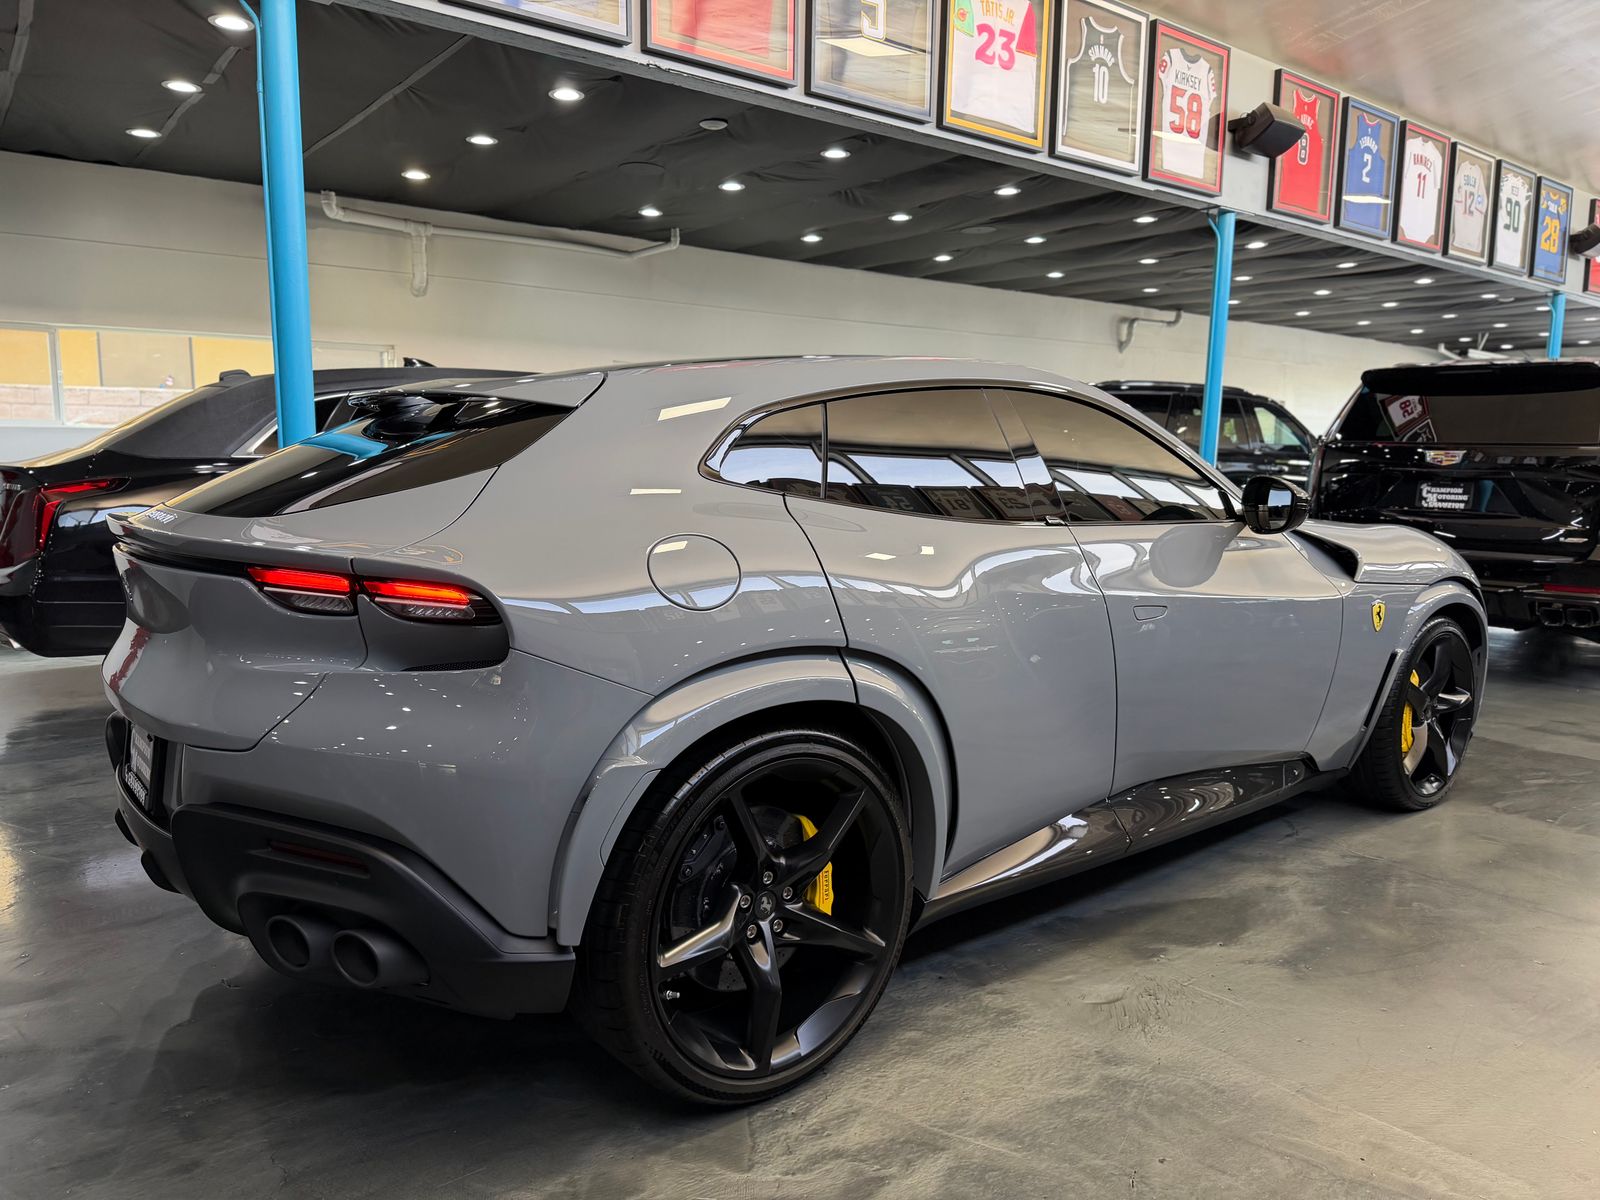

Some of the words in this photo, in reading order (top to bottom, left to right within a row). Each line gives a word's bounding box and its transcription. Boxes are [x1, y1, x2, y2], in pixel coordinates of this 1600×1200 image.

[975, 23, 1016, 70] 23
[1092, 63, 1109, 104] 10
[1174, 69, 1202, 92] KIRKSEY
[1169, 85, 1203, 139] 58
[1362, 153, 1373, 183] 2
[1417, 172, 1427, 199] 11
[1463, 190, 1475, 216] 12
[1503, 197, 1521, 233] 90
[1540, 215, 1560, 254] 28
